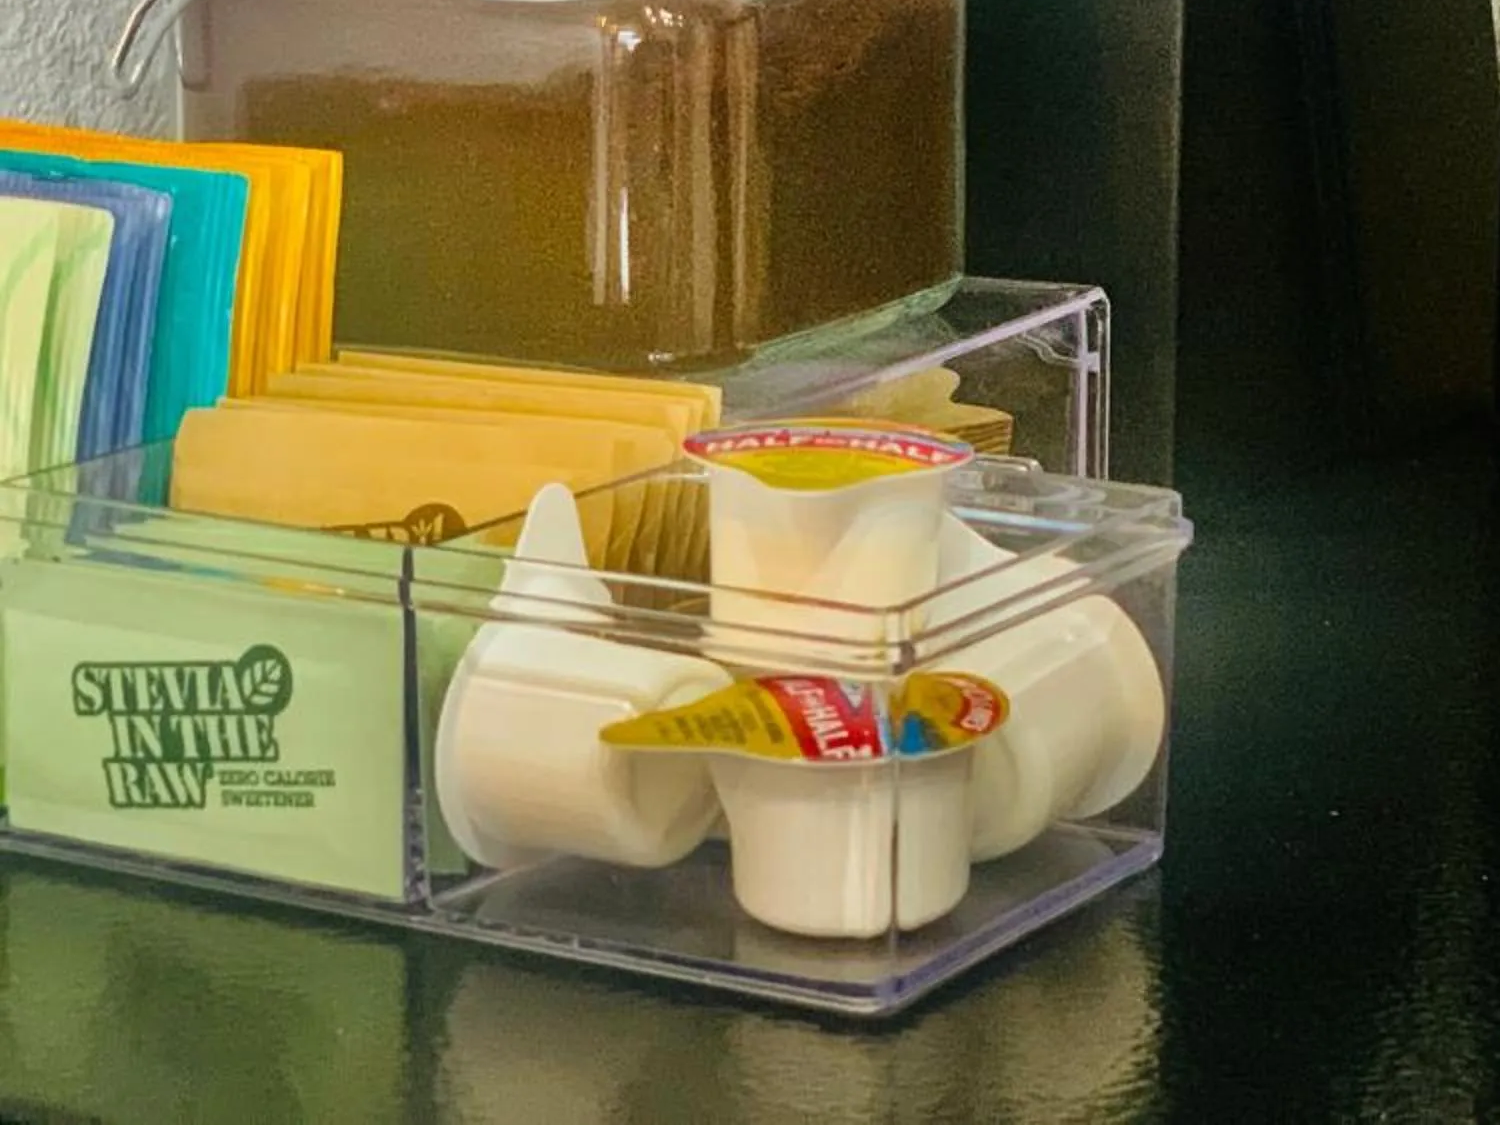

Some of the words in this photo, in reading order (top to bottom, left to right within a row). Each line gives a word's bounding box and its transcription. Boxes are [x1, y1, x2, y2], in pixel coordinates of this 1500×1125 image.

[73, 663, 247, 714] STEVIA
[111, 714, 164, 759] IN
[170, 714, 278, 759] THE
[105, 761, 208, 807] RAW
[221, 790, 316, 807] SWEETENER
[263, 770, 336, 787] CALORIE
